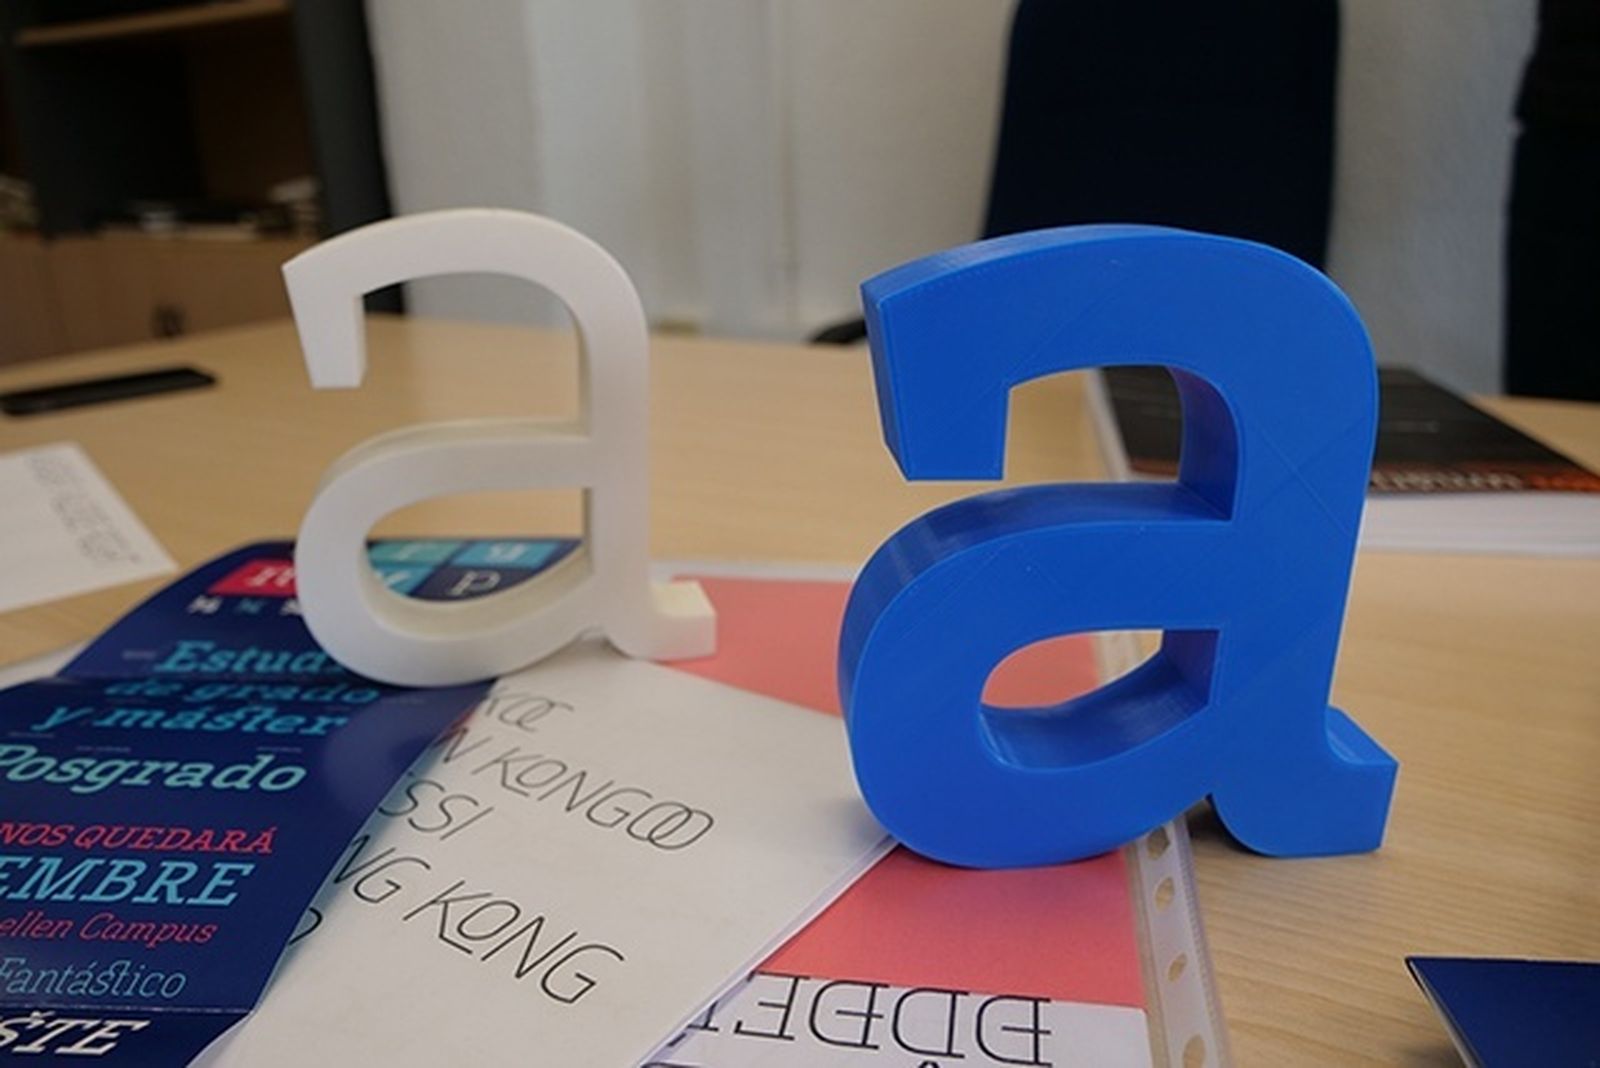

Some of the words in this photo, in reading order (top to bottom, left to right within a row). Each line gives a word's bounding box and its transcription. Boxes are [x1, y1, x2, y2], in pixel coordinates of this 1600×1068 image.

[153, 640, 342, 673] Estud
[105, 677, 183, 696] de
[184, 682, 380, 704] grado
[31, 705, 94, 731] y
[94, 705, 349, 736] máster
[0, 744, 307, 794] Posgrado
[377, 772, 494, 841] SSI
[74, 824, 278, 854] QUEDARÁ
[79, 912, 219, 948] Campus
[402, 880, 624, 1004] KONG
[0, 956, 187, 999] Fantástico
